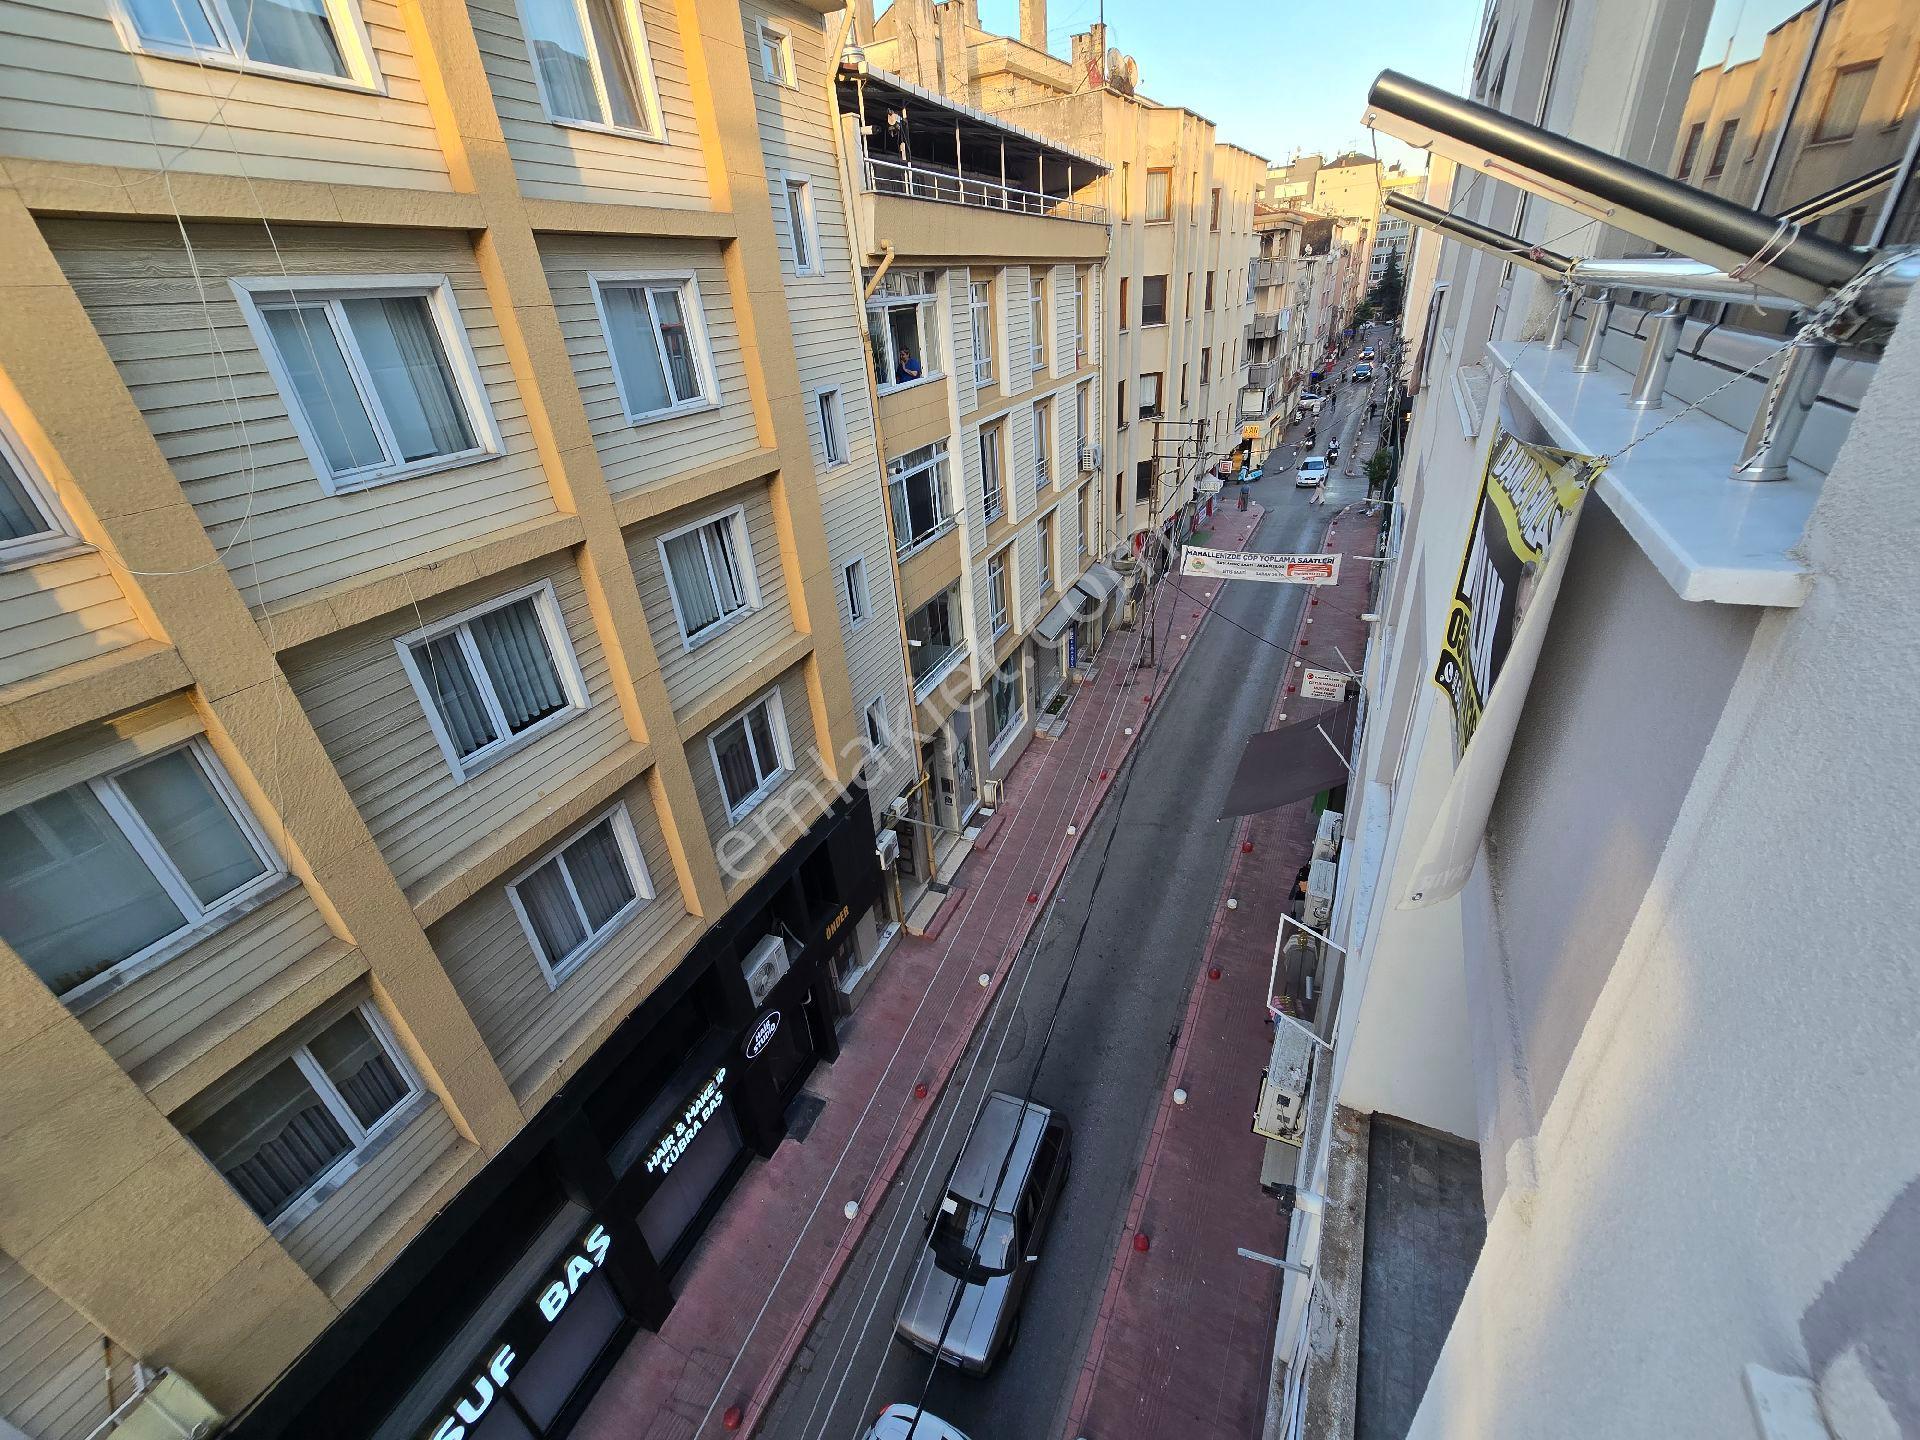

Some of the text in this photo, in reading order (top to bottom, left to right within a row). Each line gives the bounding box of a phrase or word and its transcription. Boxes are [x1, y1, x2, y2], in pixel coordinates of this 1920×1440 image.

[1242, 554, 1258, 562] ÇÖP
[1259, 555, 1296, 564] TOPLAMA
[825, 904, 850, 941] ÖNDER
[661, 1090, 725, 1174] KÜBRA BAŞ
[675, 1120, 687, 1138] &
[684, 1066, 727, 1126] MAKEUP
[537, 1223, 612, 1323] BAŞ
